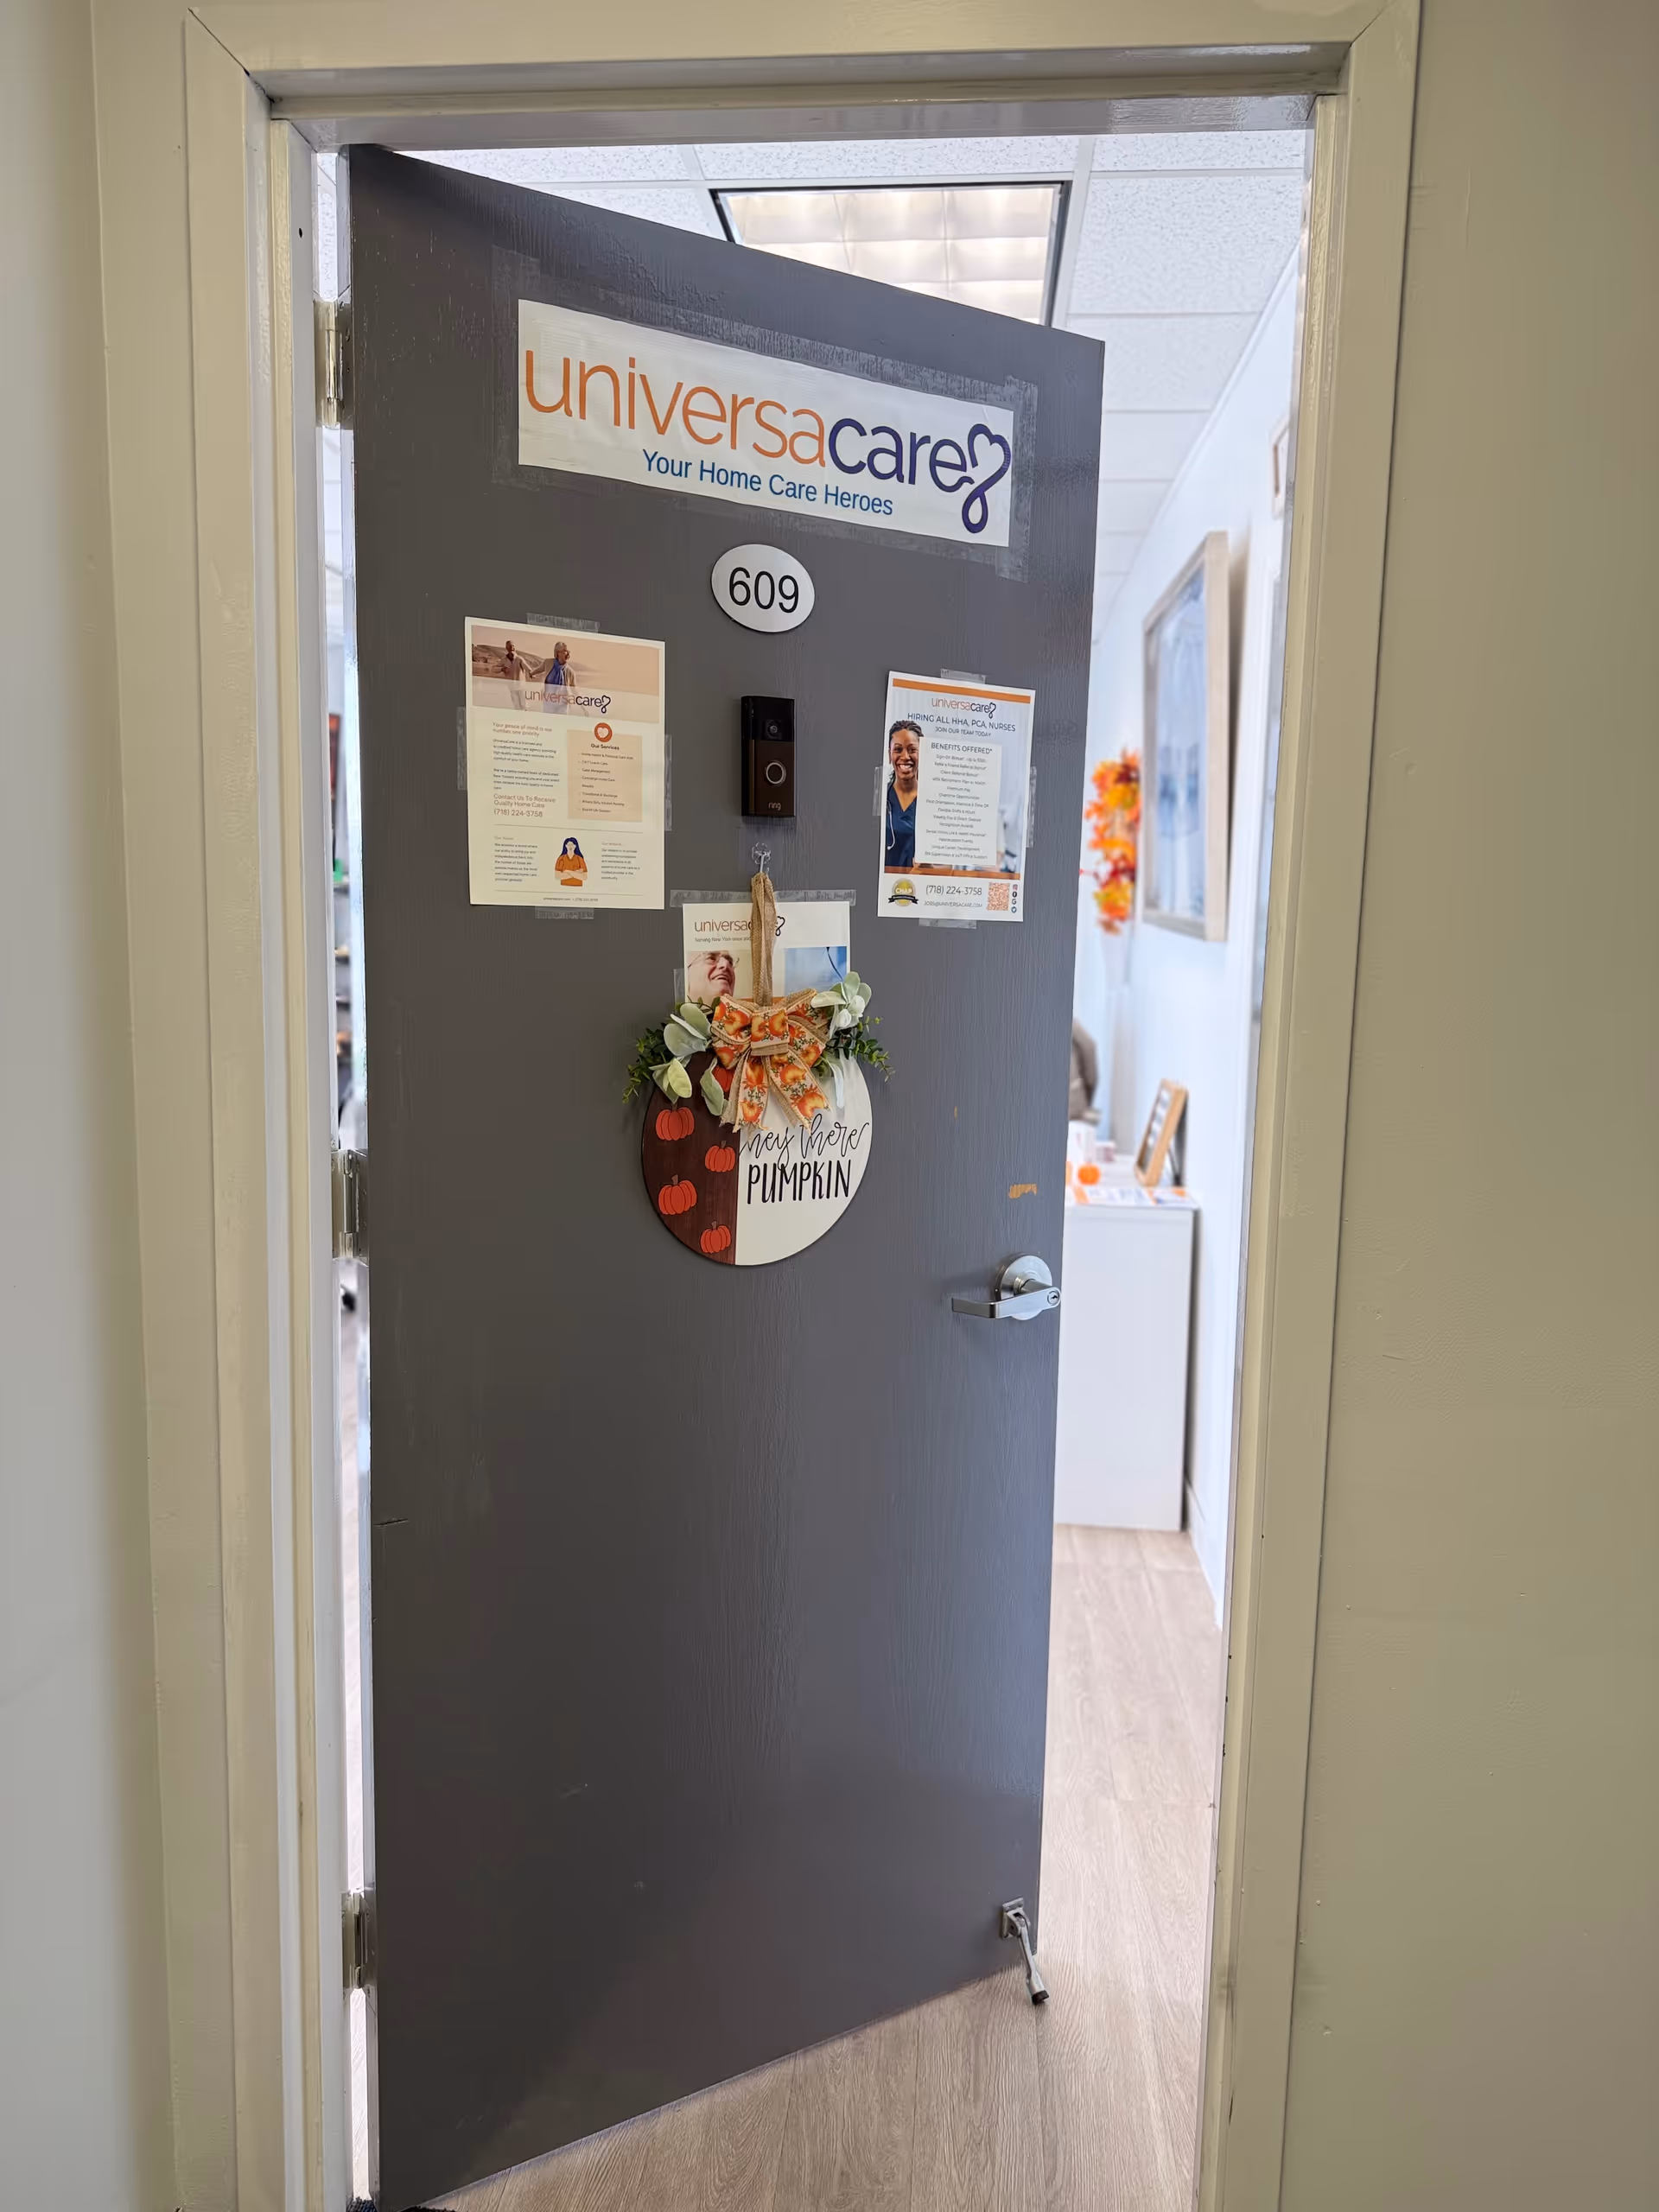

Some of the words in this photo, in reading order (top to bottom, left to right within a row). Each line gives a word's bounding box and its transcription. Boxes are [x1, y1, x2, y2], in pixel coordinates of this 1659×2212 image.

[525, 349, 975, 493] universacare
[643, 448, 692, 479] Your
[699, 459, 762, 492] Home
[769, 473, 817, 502] Care
[824, 486, 893, 516] Heroes
[728, 567, 799, 613] 609
[524, 690, 601, 708] universacare
[931, 697, 991, 714] universacare
[907, 712, 935, 722] HIRING
[936, 715, 950, 724] ALL
[951, 717, 969, 728] HHA,
[971, 719, 988, 729] PCA,
[988, 722, 1016, 732] NURSES
[931, 742, 961, 752] BENEFITS
[511, 809, 543, 818] 224-3758
[768, 801, 782, 811] ring
[925, 885, 944, 895] (718)
[946, 886, 982, 896] 224-3758
[799, 1113, 870, 1160] there
[747, 1159, 851, 1205] PUMPKIN
